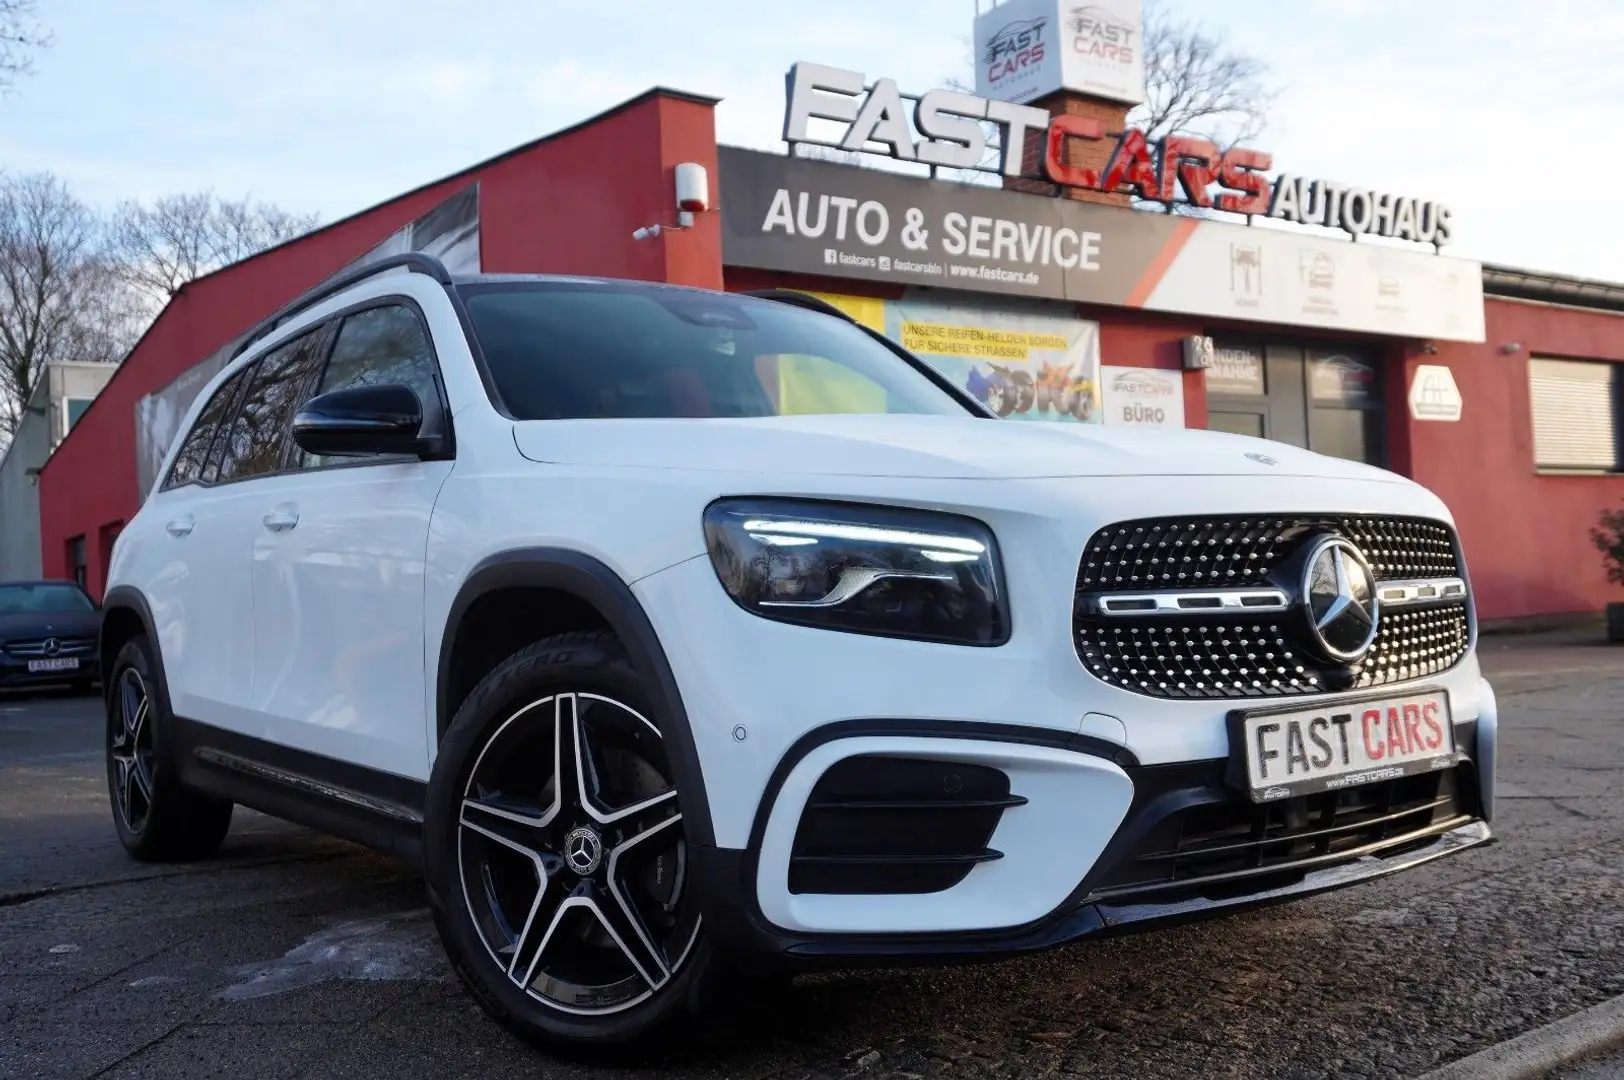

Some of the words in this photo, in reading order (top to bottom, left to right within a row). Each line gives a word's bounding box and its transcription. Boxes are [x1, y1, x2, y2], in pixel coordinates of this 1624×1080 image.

[990, 21, 1047, 62] FAST
[1076, 18, 1135, 45] FAST
[988, 42, 1045, 83] CARS
[1074, 36, 1134, 64] CARS
[784, 61, 1049, 177] FAST
[1046, 114, 1272, 215] CARS
[1268, 173, 1453, 246] AUTOHAUS
[762, 188, 890, 246] AUTO
[901, 207, 928, 251] &
[942, 212, 1102, 272] SERVICE
[839, 252, 876, 267] fastcars
[951, 264, 1039, 285] www.fastcars.de
[903, 325, 945, 338] UNSERE
[1193, 335, 1212, 352] 26
[927, 340, 973, 354] SICHERE
[1123, 401, 1165, 424] BÜRO
[1257, 713, 1352, 780] FAST
[1362, 701, 1443, 760] CARS
